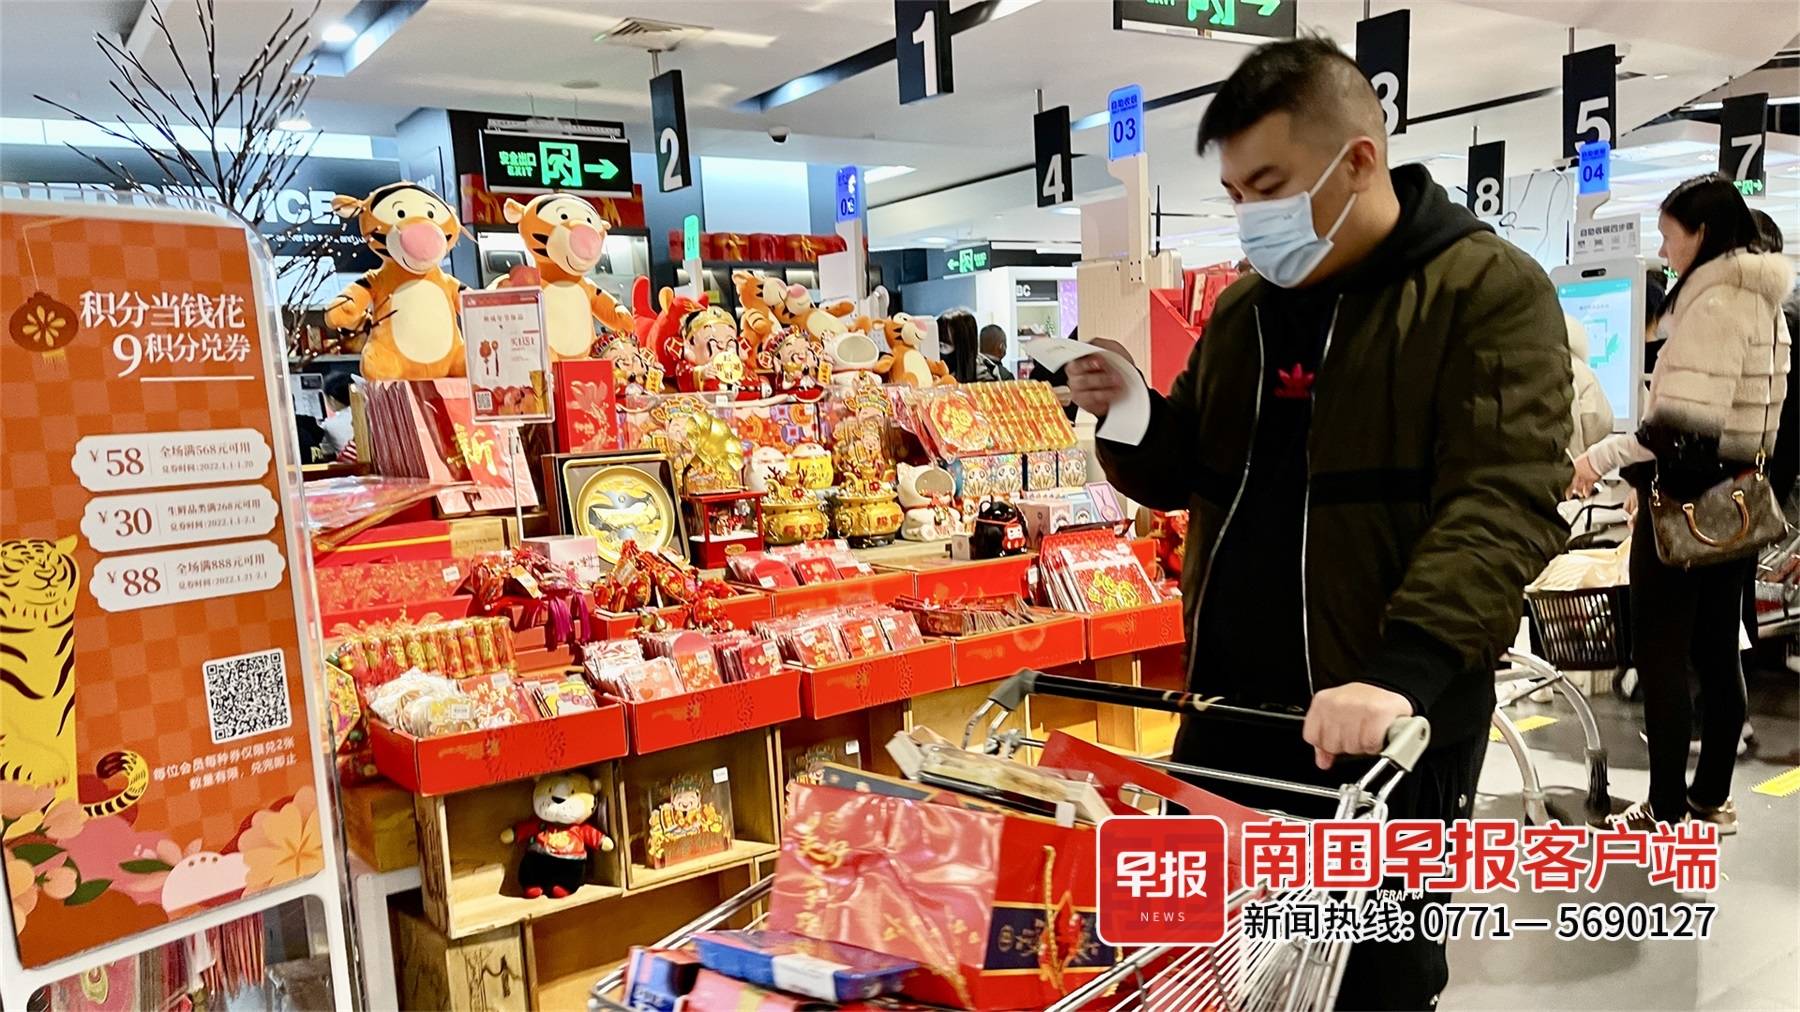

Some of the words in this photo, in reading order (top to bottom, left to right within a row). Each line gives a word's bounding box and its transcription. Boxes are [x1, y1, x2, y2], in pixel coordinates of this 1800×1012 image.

[911, 9, 938, 98] 1
[1113, 117, 1136, 144] 03
[1574, 96, 1612, 150] 5
[507, 165, 534, 177] EXIT
[658, 127, 683, 193] 2
[1042, 154, 1065, 203] 4
[1583, 164, 1605, 182] 04
[1730, 135, 1762, 182] 7
[1473, 177, 1501, 218] 8
[79, 290, 246, 329] 积分当钱花
[160, 441, 251, 458] 全场满568元可用
[176, 553, 265, 575] 全场满888元可用
